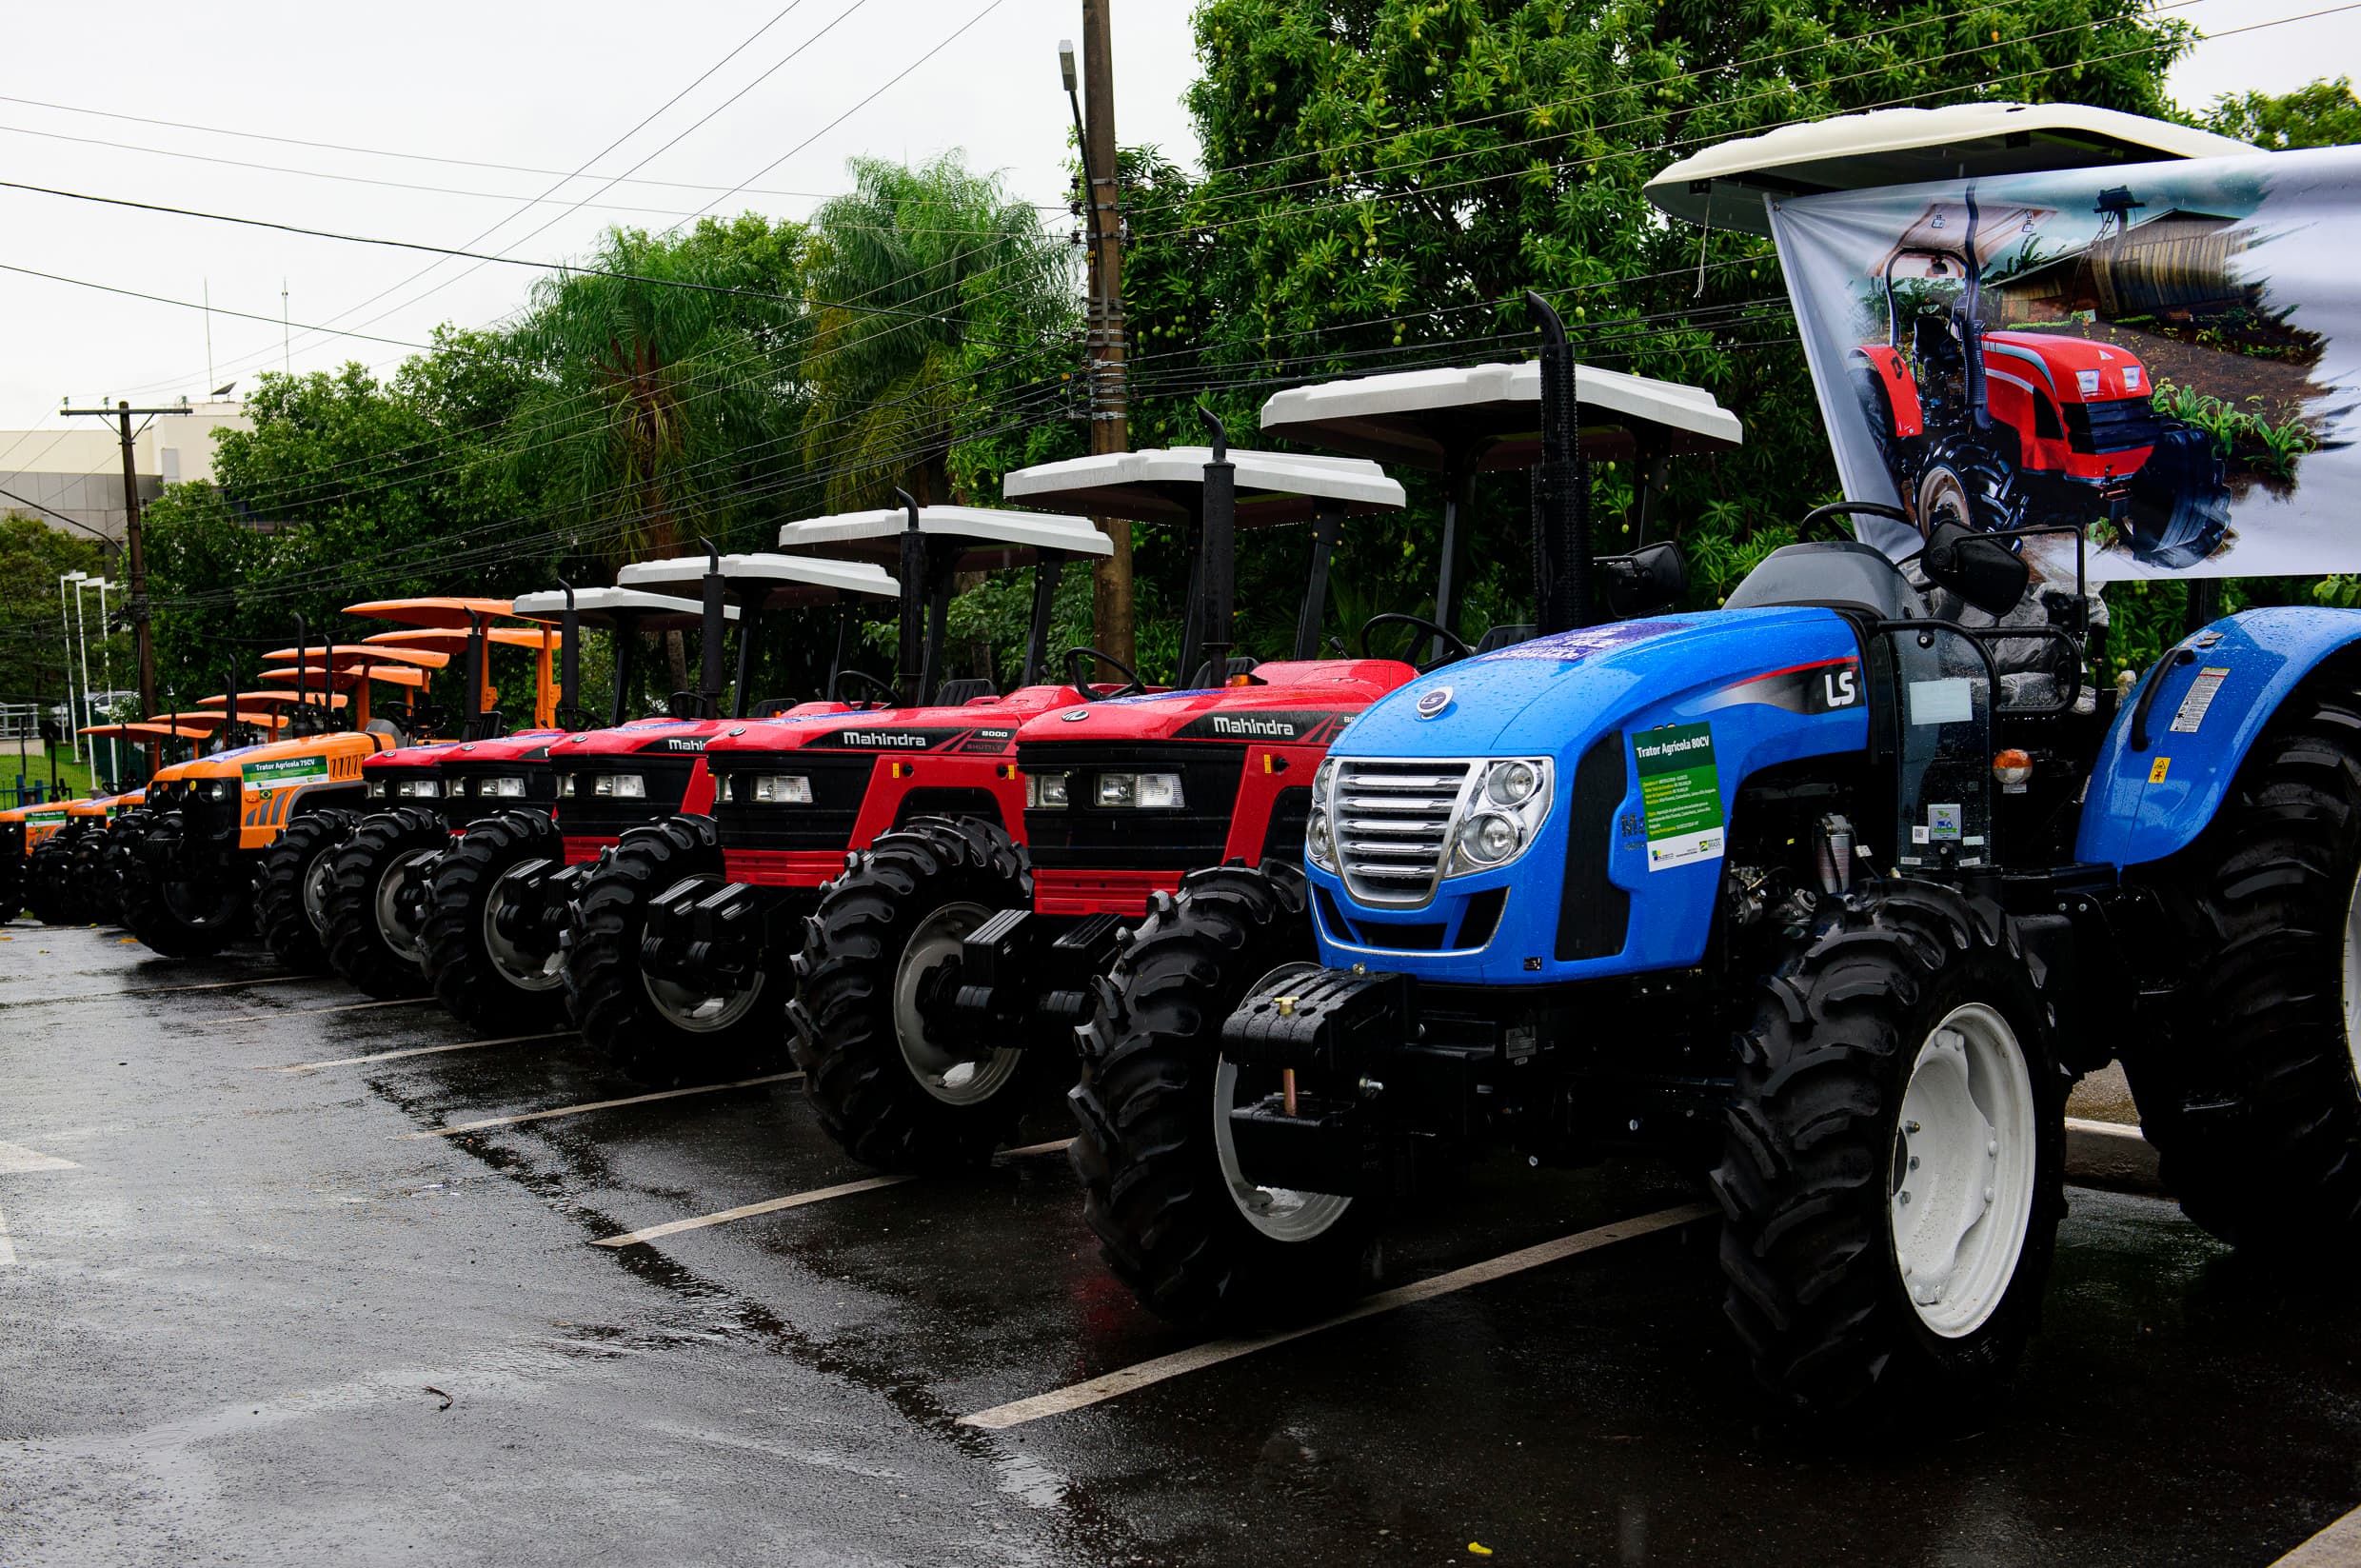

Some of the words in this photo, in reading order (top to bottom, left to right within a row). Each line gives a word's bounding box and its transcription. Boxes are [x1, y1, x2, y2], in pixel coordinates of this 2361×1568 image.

[1825, 671, 1855, 706] LS
[1213, 716, 1295, 736] Mahindra
[843, 731, 926, 746] Mahindra
[1636, 746, 1661, 759] Trator
[1661, 739, 1691, 756] Agrícola
[1691, 735, 1710, 749] 80CV
